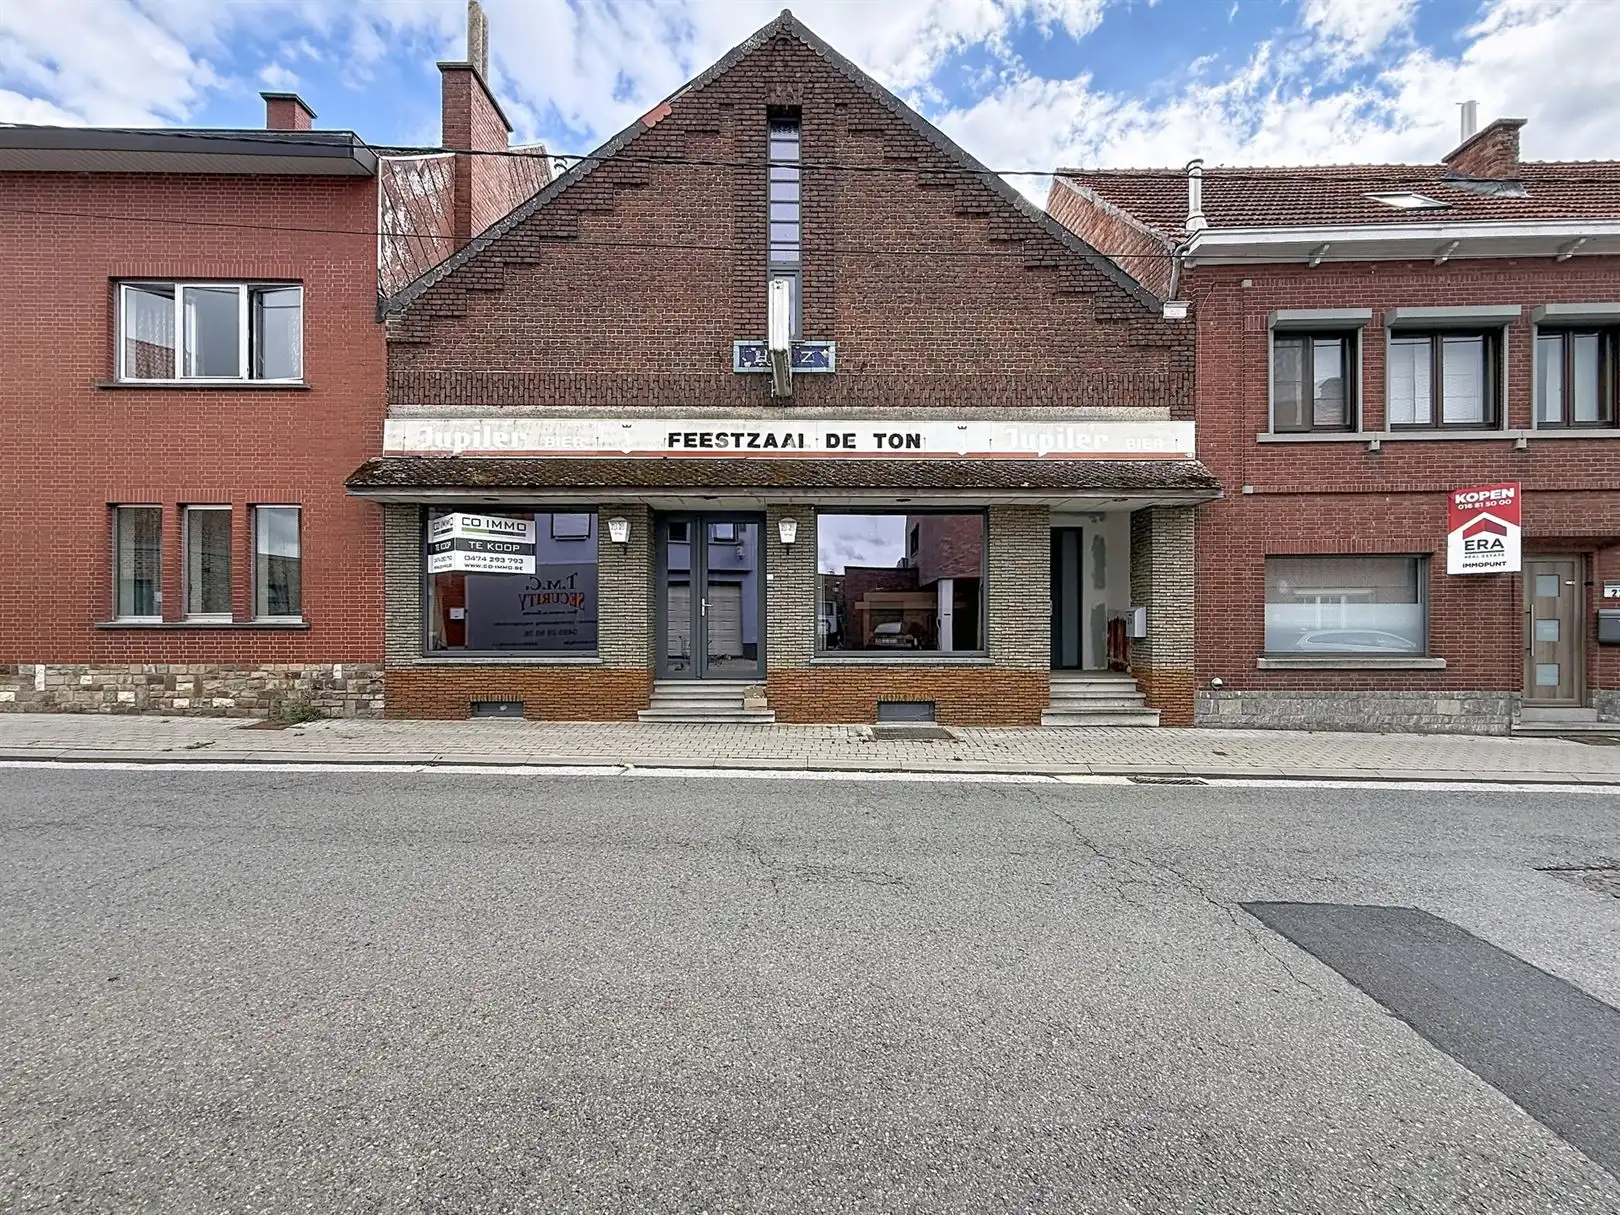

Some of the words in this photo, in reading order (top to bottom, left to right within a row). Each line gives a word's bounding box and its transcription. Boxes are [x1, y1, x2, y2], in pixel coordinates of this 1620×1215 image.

[418, 425, 527, 454] Jupiler
[826, 432, 857, 449] DE
[873, 433, 921, 449] TON
[1004, 426, 1110, 456] Jupiler
[1455, 487, 1515, 504] KOPEN
[461, 516, 481, 527] CO
[486, 519, 527, 532] IMMO
[469, 541, 483, 550] TE
[487, 542, 520, 552] KOOP
[1464, 538, 1505, 551] ERA
[1462, 560, 1507, 568] IMMOPUNT
